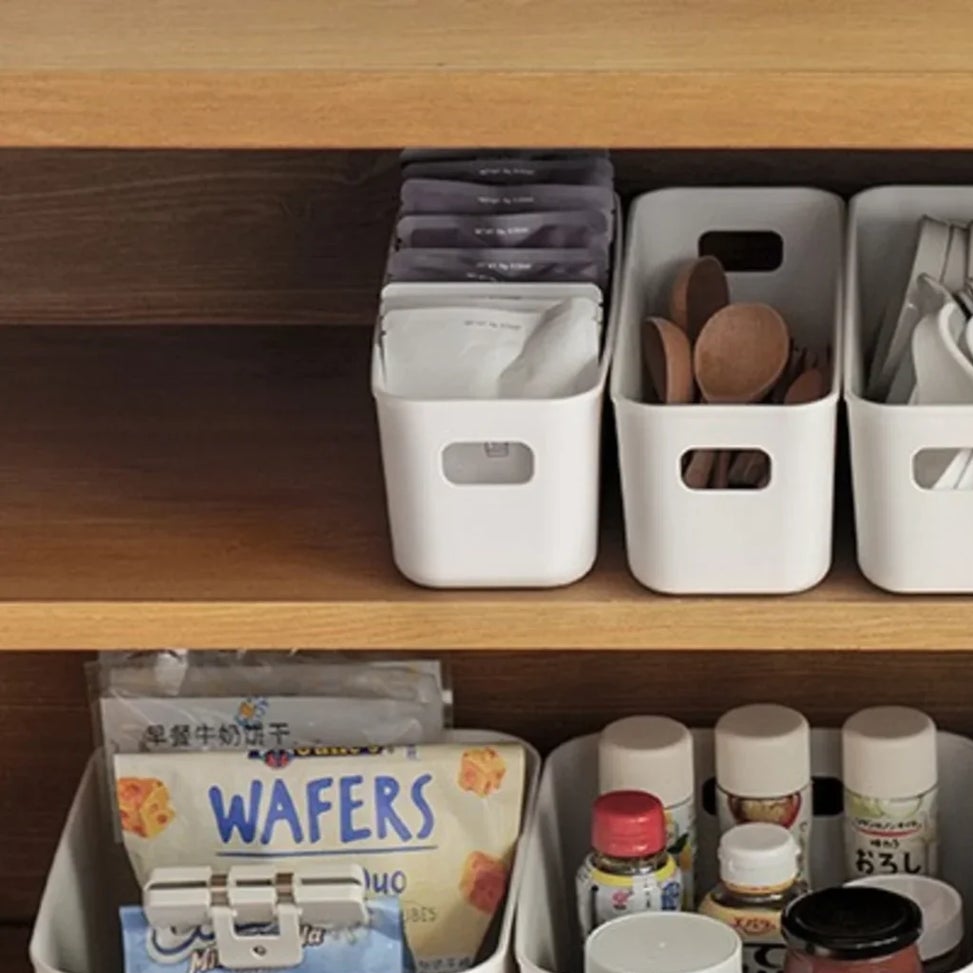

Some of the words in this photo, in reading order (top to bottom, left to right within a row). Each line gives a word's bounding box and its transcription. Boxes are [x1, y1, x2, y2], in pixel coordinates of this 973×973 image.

[208, 774, 435, 845] WAFERS
[855, 848, 922, 874] おろし
